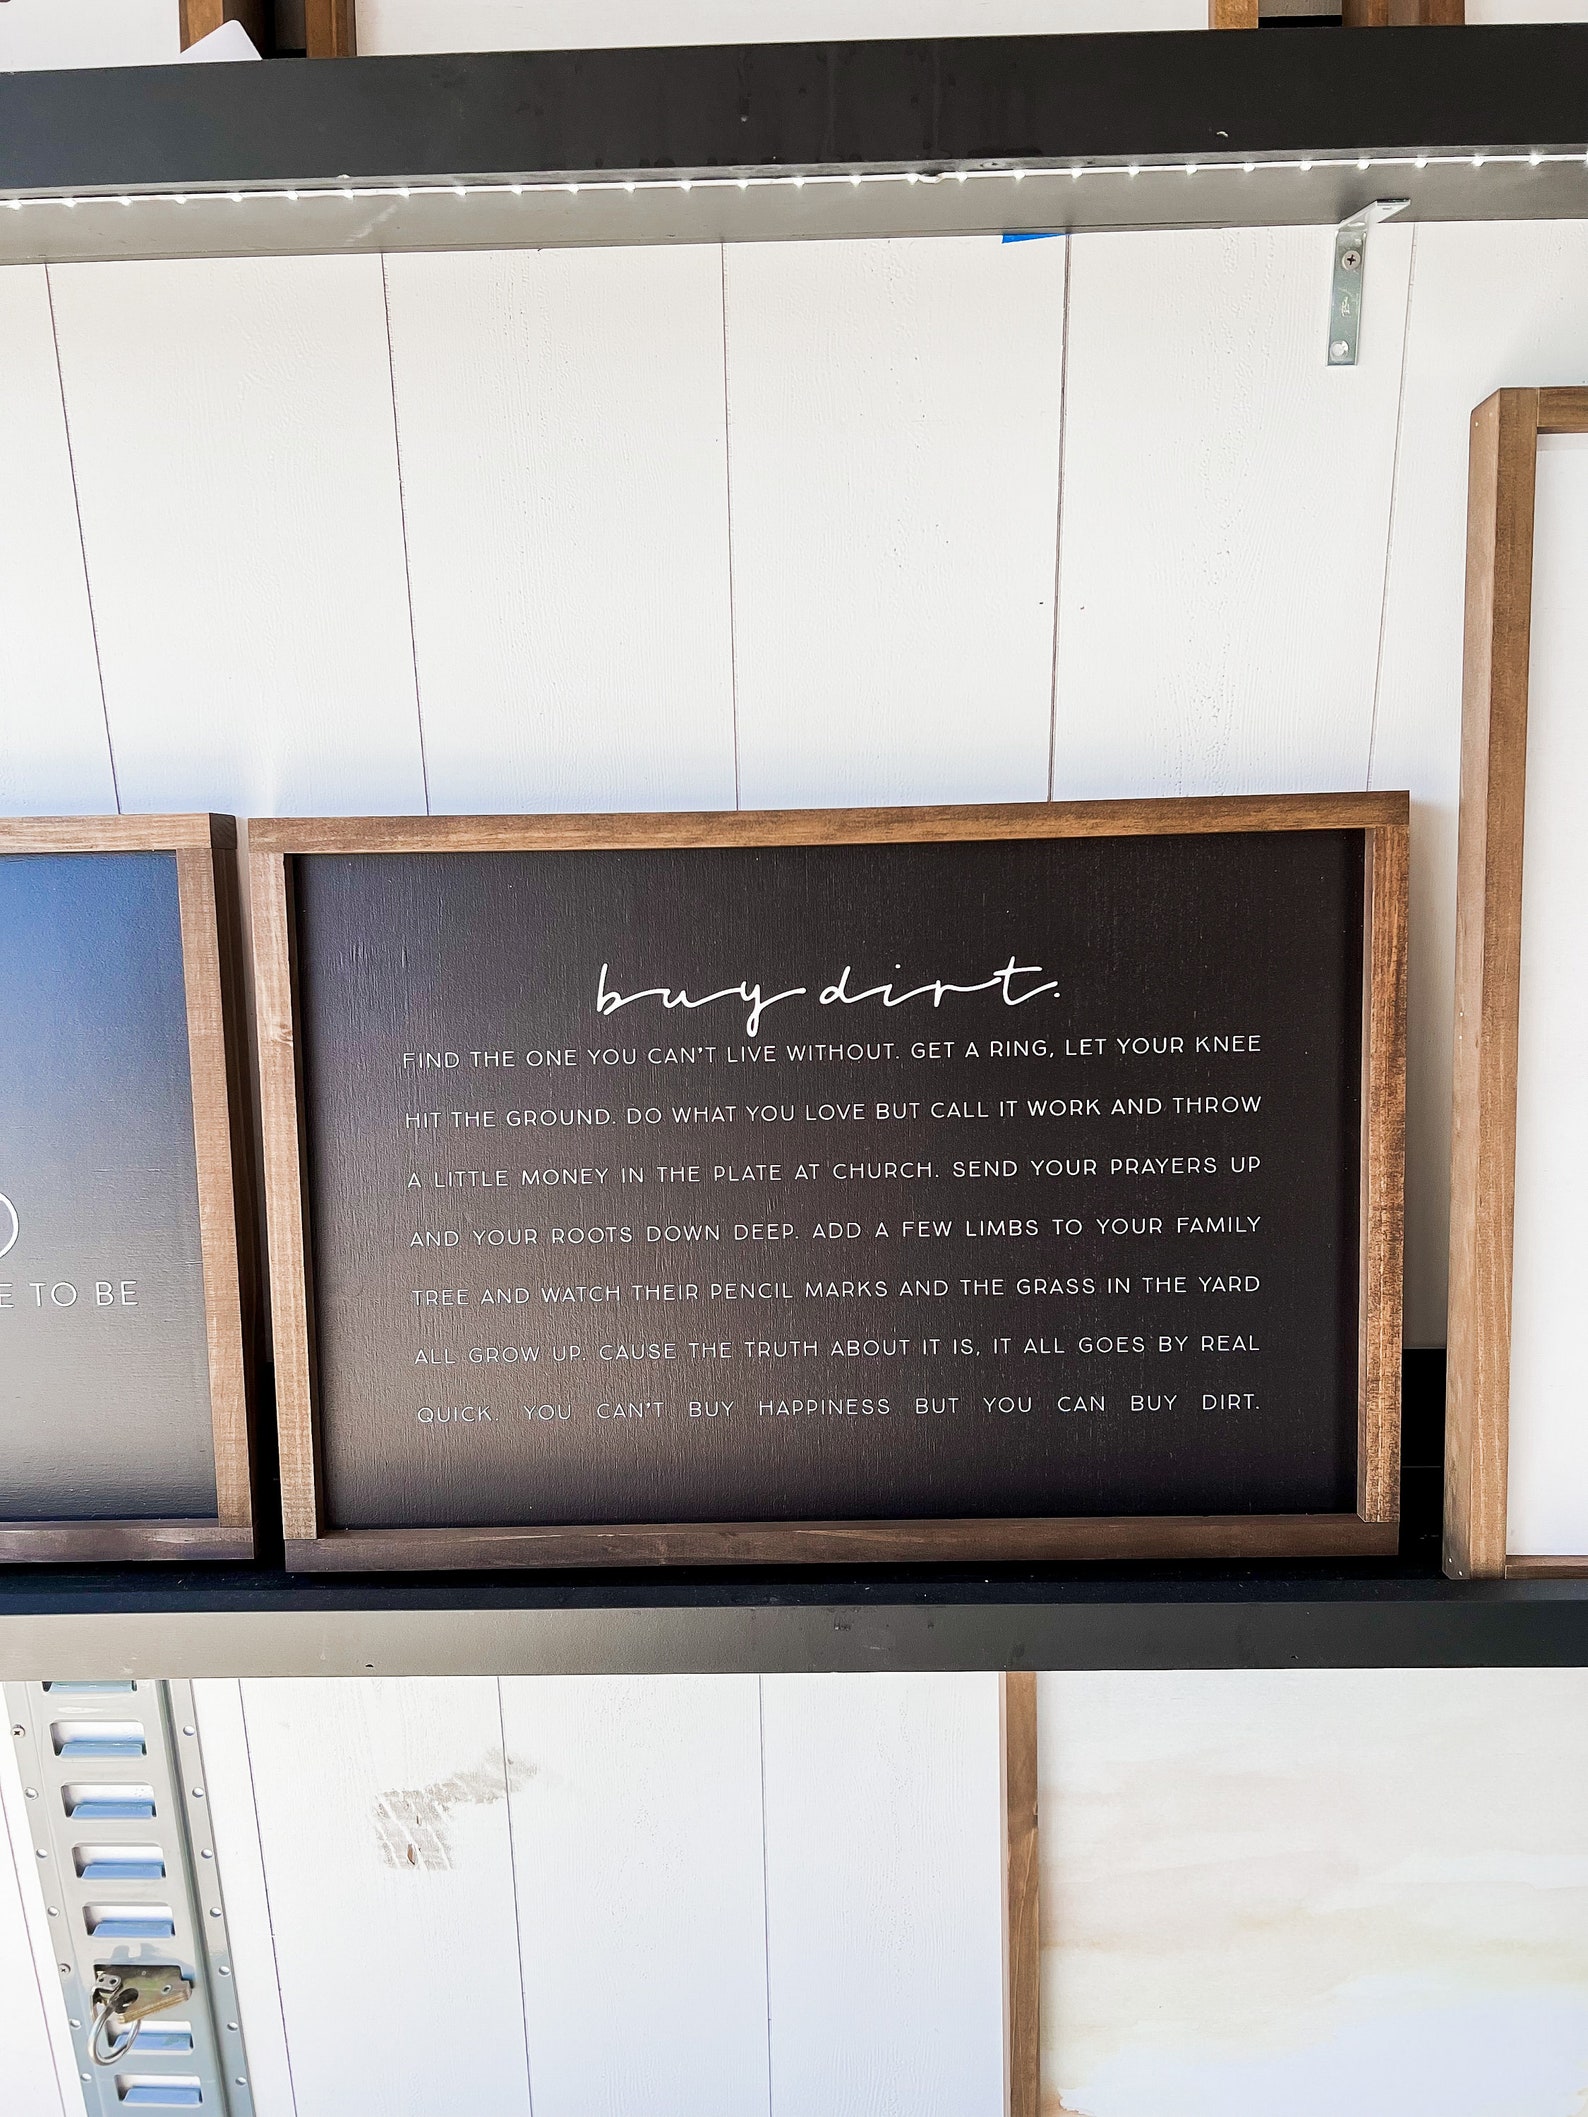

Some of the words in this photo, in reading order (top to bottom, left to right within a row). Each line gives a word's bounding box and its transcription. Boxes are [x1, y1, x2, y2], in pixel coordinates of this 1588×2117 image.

[596, 963, 807, 1038] buy
[819, 955, 1061, 1008] dirt.
[403, 1051, 460, 1069] FIND
[469, 1050, 515, 1068] THE
[526, 1049, 577, 1067] ONE
[587, 1048, 636, 1065] YOU
[648, 1046, 717, 1064] CAN'T
[727, 1045, 776, 1063] LIVE
[786, 1043, 900, 1061] WITHOUT.
[911, 1041, 955, 1059] GET
[964, 1041, 980, 1058] A
[990, 1039, 1054, 1058] RING,
[1066, 1038, 1107, 1056] LET
[1116, 1036, 1184, 1055] YOUR
[1196, 1034, 1261, 1053] KNEE
[405, 1112, 442, 1129] HIT
[450, 1111, 496, 1128] THE
[506, 1108, 616, 1127] GROUND.
[627, 1107, 662, 1124] DO
[671, 1105, 737, 1123] WHAT
[745, 1104, 794, 1122] YOU
[806, 1103, 865, 1121] LOVE
[876, 1102, 920, 1120] BUT
[930, 1101, 989, 1119] CALL
[1000, 1100, 1018, 1117] IT
[1027, 1098, 1101, 1117] WORK
[1110, 1098, 1162, 1115] AND
[1172, 1096, 1262, 1114] THROW
[407, 1172, 422, 1188] A
[434, 1170, 509, 1188] LITTLE
[521, 1168, 609, 1186] MONEY
[621, 1167, 644, 1184] IN
[656, 1165, 701, 1183] THE
[714, 1164, 782, 1182] PLATE
[794, 1163, 820, 1180] AT
[832, 1161, 939, 1180] CHURCH.
[952, 1160, 1018, 1178] SEND
[1030, 1159, 1097, 1176] YOUR
[1111, 1157, 1217, 1175] PRAYERS
[1231, 1156, 1261, 1173] UP
[410, 1230, 460, 1247] AND
[472, 1228, 537, 1246] YOUR
[552, 1226, 632, 1244] ROOTS
[646, 1224, 720, 1242] DOWN
[734, 1223, 799, 1241] DEEP.
[812, 1222, 861, 1239] ADD
[874, 1221, 889, 1238] A
[902, 1220, 952, 1238] FEW
[966, 1219, 1039, 1237] LIMBS
[1051, 1219, 1083, 1235] TO
[1096, 1217, 1163, 1235] YOUR
[1177, 1216, 1261, 1234] FAMILY
[29, 1281, 78, 1307] TO
[95, 1280, 139, 1307] BE
[411, 1289, 469, 1306] TREE
[480, 1287, 530, 1305] AND
[541, 1285, 620, 1303] WATCH
[631, 1284, 698, 1301] THEIR
[710, 1282, 793, 1300] PENCIL
[805, 1280, 888, 1298] MARKS
[899, 1280, 949, 1297] AND
[959, 1279, 1004, 1296] THE
[1016, 1278, 1095, 1295] GRASS
[1108, 1277, 1130, 1294] IN
[1141, 1276, 1187, 1294] THE
[1198, 1275, 1260, 1292] YARD
[414, 1348, 456, 1365] ALL
[468, 1346, 540, 1363] GROW
[553, 1345, 586, 1362] UP.
[599, 1343, 676, 1361] CAUSE
[688, 1342, 732, 1359] THE
[744, 1340, 817, 1358] TRUTH
[830, 1339, 910, 1357] ABOUT
[921, 1338, 941, 1355] IT
[953, 1338, 980, 1357] IS,
[992, 1338, 1012, 1354] IT
[1023, 1337, 1065, 1354] ALL
[1078, 1336, 1145, 1353] GOES
[1159, 1335, 1189, 1352] BY
[1201, 1334, 1260, 1352] REAL
[417, 1405, 498, 1423] QUICK.
[523, 1404, 571, 1421] YOU
[596, 1402, 664, 1419] CAN'T
[689, 1401, 734, 1417] BUY
[759, 1398, 890, 1416] HAPPINESS
[915, 1397, 959, 1414] BUT
[983, 1396, 1032, 1413] YOU
[1057, 1395, 1105, 1412] CAN
[1131, 1394, 1177, 1412] BUY
[1202, 1393, 1260, 1410] DIRT.
